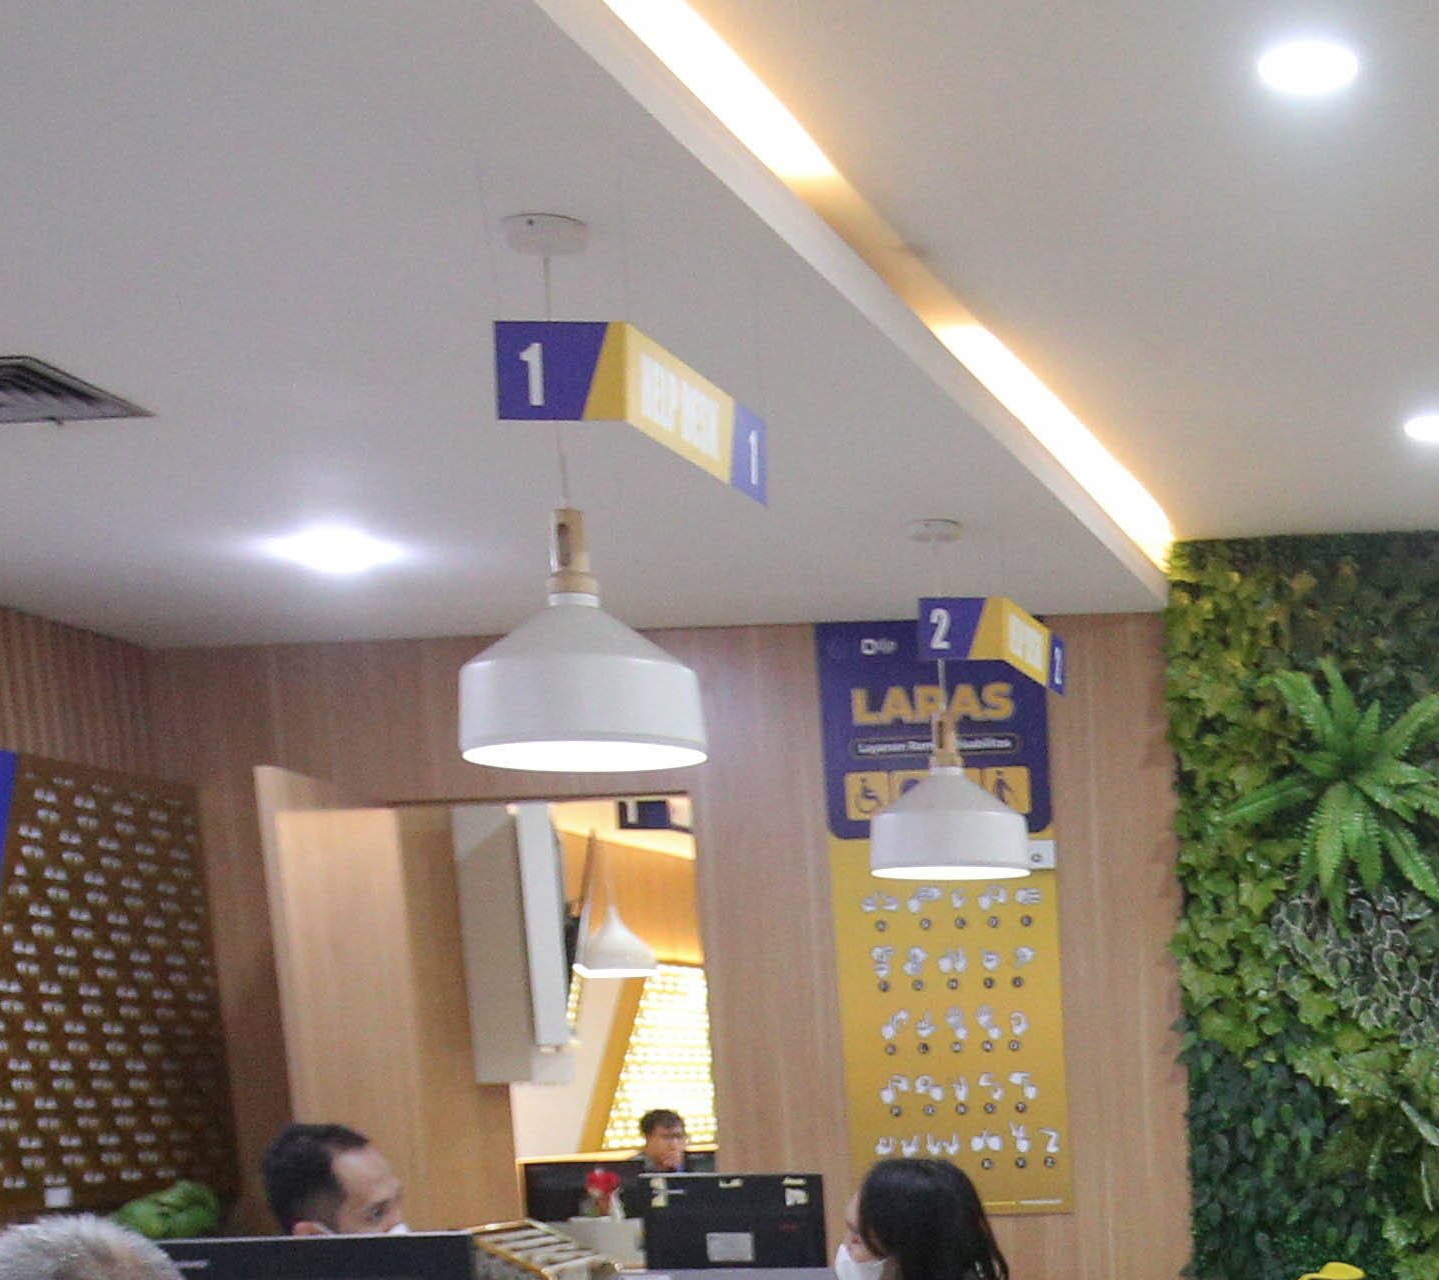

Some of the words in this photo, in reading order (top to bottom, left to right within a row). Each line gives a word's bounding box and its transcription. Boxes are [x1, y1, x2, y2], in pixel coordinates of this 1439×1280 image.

[519, 342, 546, 407] 1
[748, 429, 759, 486] 1
[929, 608, 951, 649] 2
